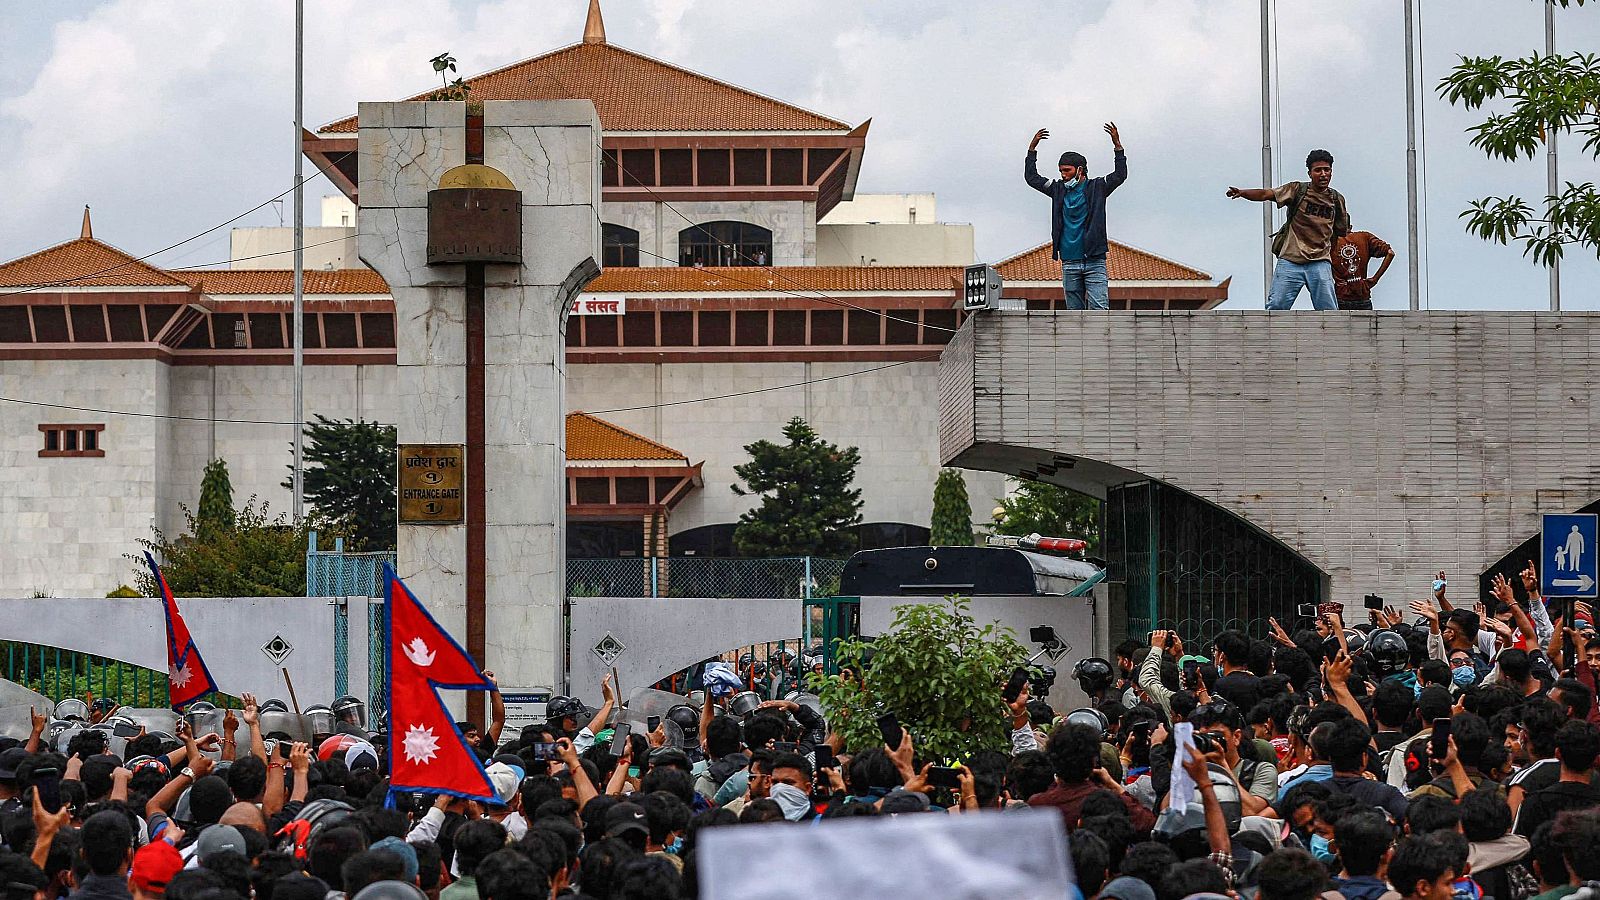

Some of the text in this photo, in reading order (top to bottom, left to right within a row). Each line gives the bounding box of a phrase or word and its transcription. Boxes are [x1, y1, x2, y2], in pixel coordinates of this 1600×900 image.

[585, 297, 619, 313] संसद
[405, 454, 457, 469] प्रवेश द्वार
[403, 489, 459, 499] ENTRANCE GATE
[425, 503, 435, 513] 1
